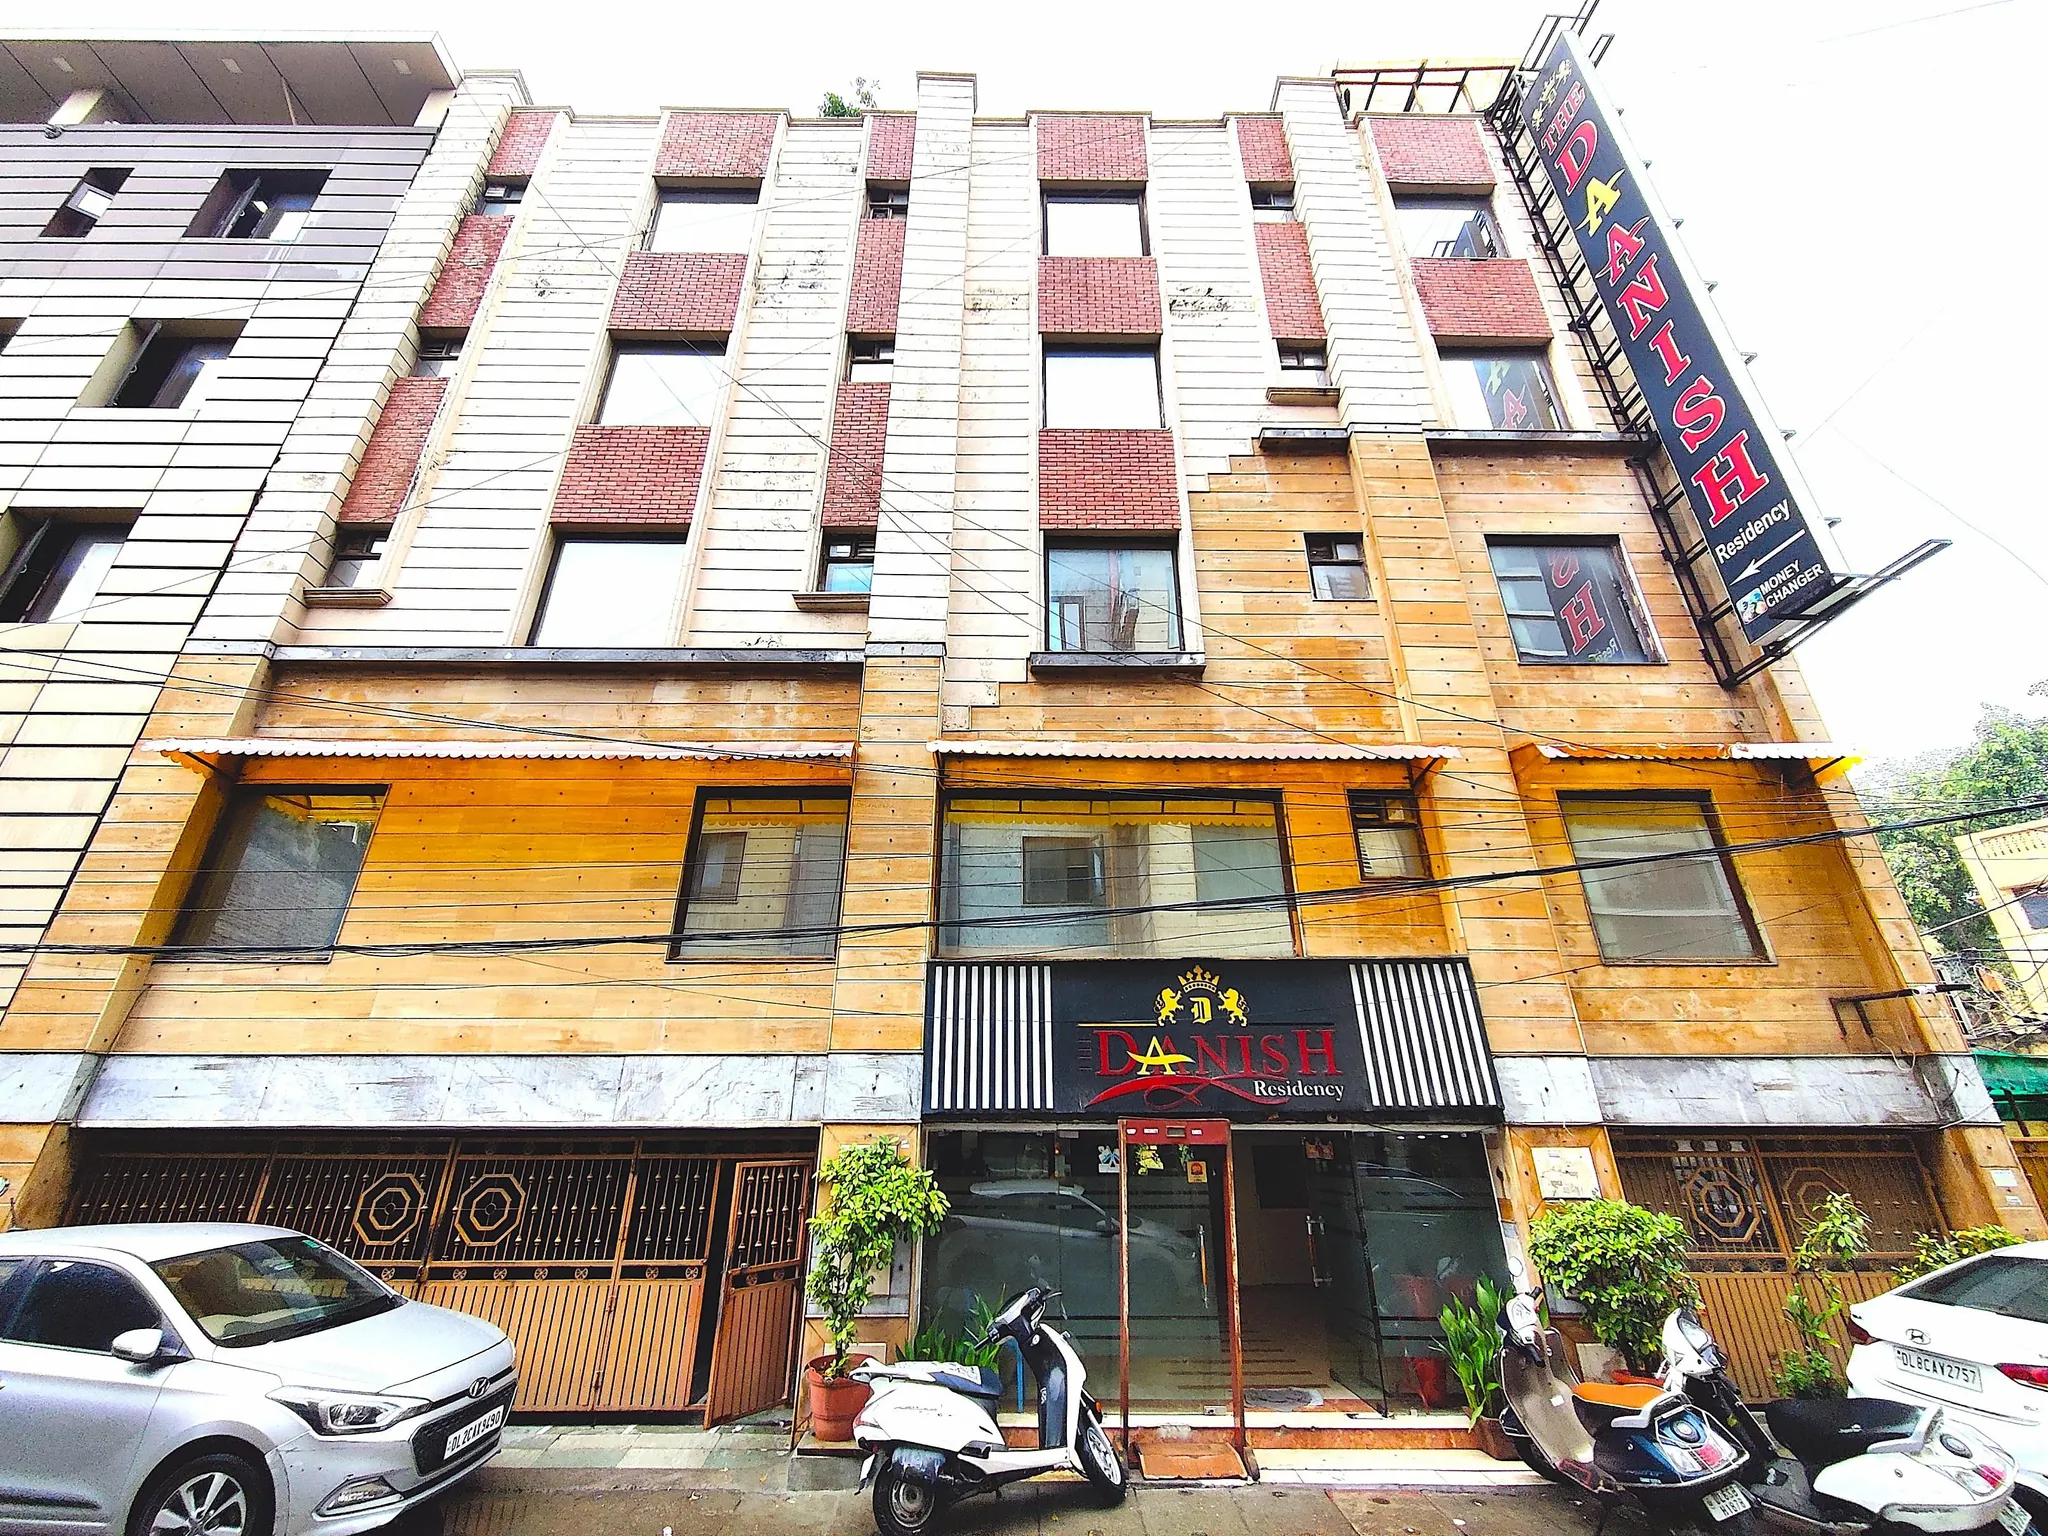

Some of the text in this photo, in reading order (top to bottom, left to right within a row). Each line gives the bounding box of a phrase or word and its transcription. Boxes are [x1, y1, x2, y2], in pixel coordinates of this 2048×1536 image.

[1541, 80, 1586, 156] THE
[1554, 119, 1770, 529] DAANISH
[1714, 499, 1791, 564] Residency
[1760, 559, 1801, 595] MONEY
[1765, 563, 1825, 607] CHANGER
[1253, 1079, 1344, 1102] Residency
[1901, 1351, 1977, 1384] DL8CAY2757
